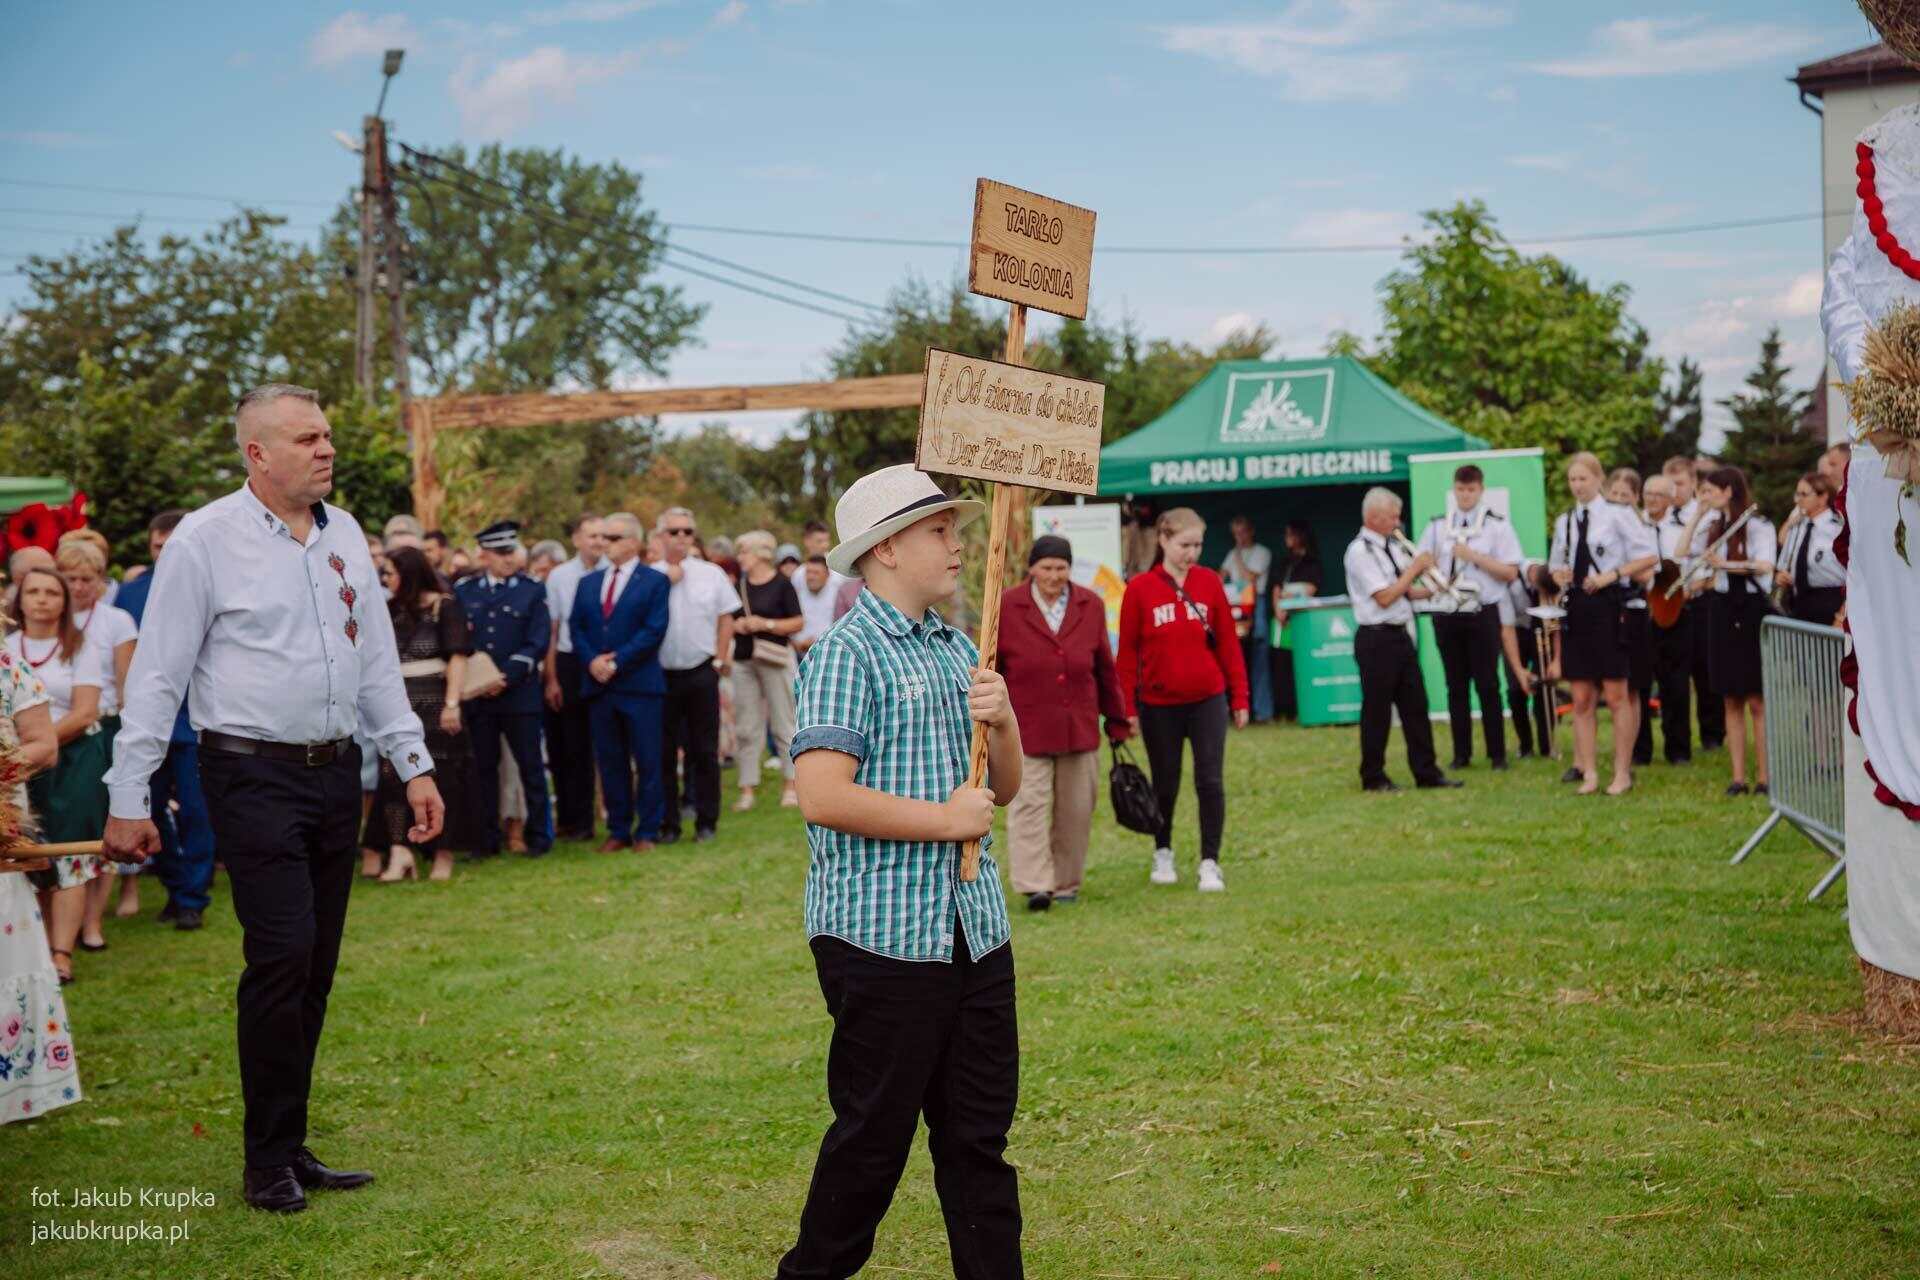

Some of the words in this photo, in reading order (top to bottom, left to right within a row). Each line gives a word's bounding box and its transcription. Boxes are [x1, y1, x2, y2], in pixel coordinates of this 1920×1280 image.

[1005, 202, 1063, 245] TARŁO
[993, 252, 1073, 300] KOLONIA
[956, 365, 987, 406] Od
[984, 377, 1033, 416] ziarna
[1036, 382, 1054, 418] do
[1056, 387, 1099, 428] chleba
[947, 432, 980, 467] Dar
[981, 437, 1025, 474] Ziemi
[1028, 444, 1057, 479] Dar
[1056, 449, 1095, 486] Nieba
[1150, 457, 1239, 486] PRACUJ
[1244, 449, 1393, 481] BEZPIECZNIE
